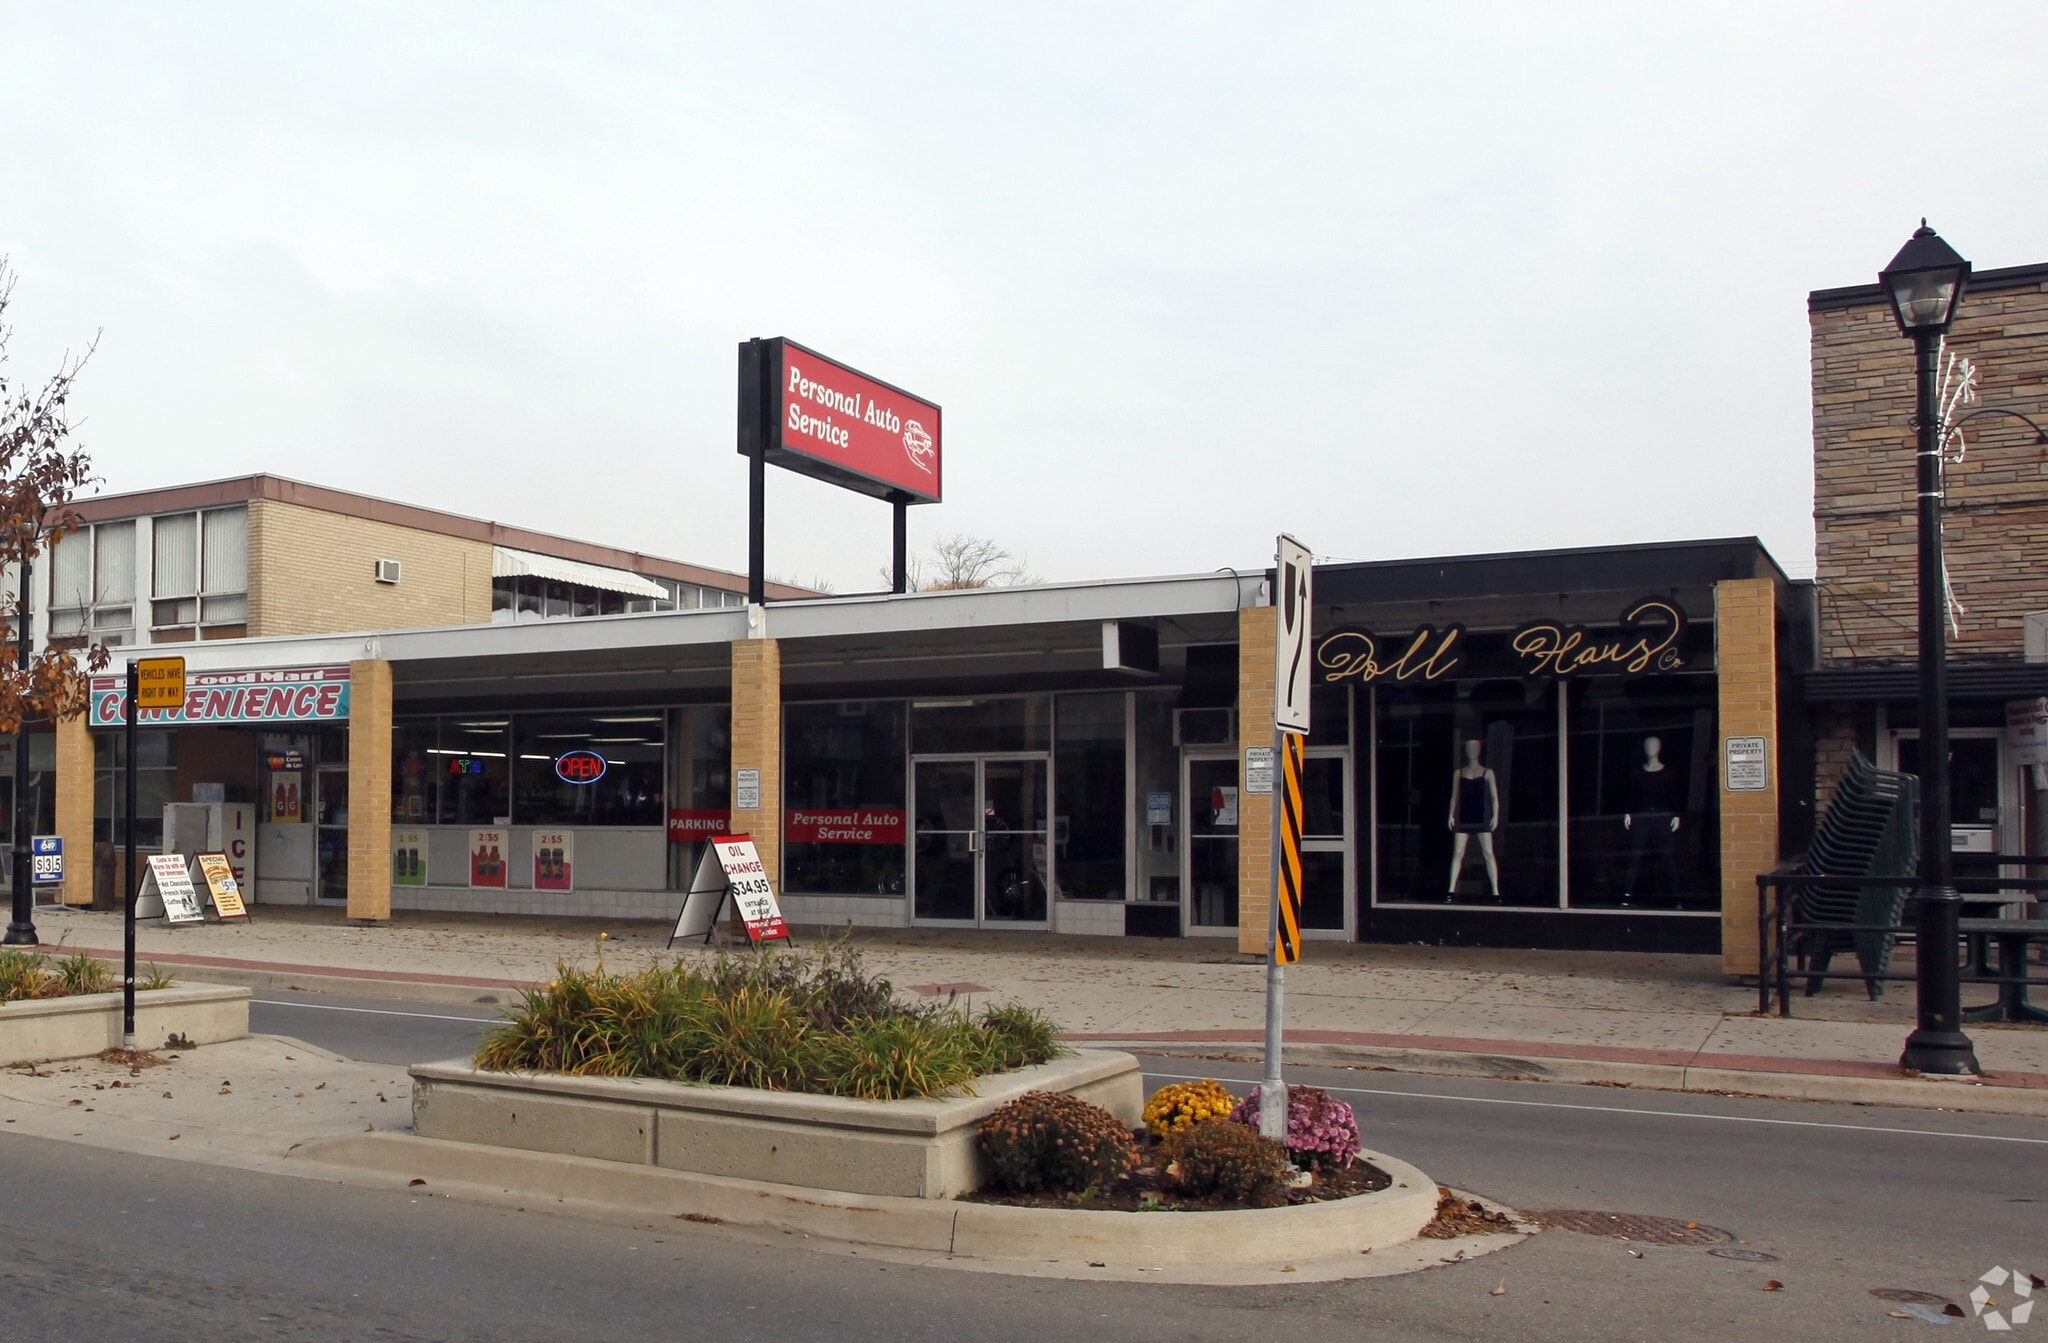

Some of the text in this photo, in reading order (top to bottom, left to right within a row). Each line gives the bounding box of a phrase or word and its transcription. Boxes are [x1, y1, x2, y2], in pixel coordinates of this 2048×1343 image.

[788, 366, 900, 434] Personal Auto
[788, 403, 849, 448] Service
[1318, 628, 1458, 681] Doll
[141, 668, 181, 679] VEHICLES HAVE
[186, 670, 324, 685] Food Mart
[142, 686, 180, 698] RIGHT OF WAY
[449, 759, 482, 774] ATM
[559, 758, 601, 776] OPEN
[277, 801, 284, 810] G
[289, 801, 296, 810] G
[670, 819, 724, 830] PARKING
[793, 813, 899, 825] Personal Auto
[818, 827, 872, 839] Service
[728, 846, 745, 857] OIL
[724, 861, 763, 875] CHANGE
[732, 879, 769, 896] $34.95
